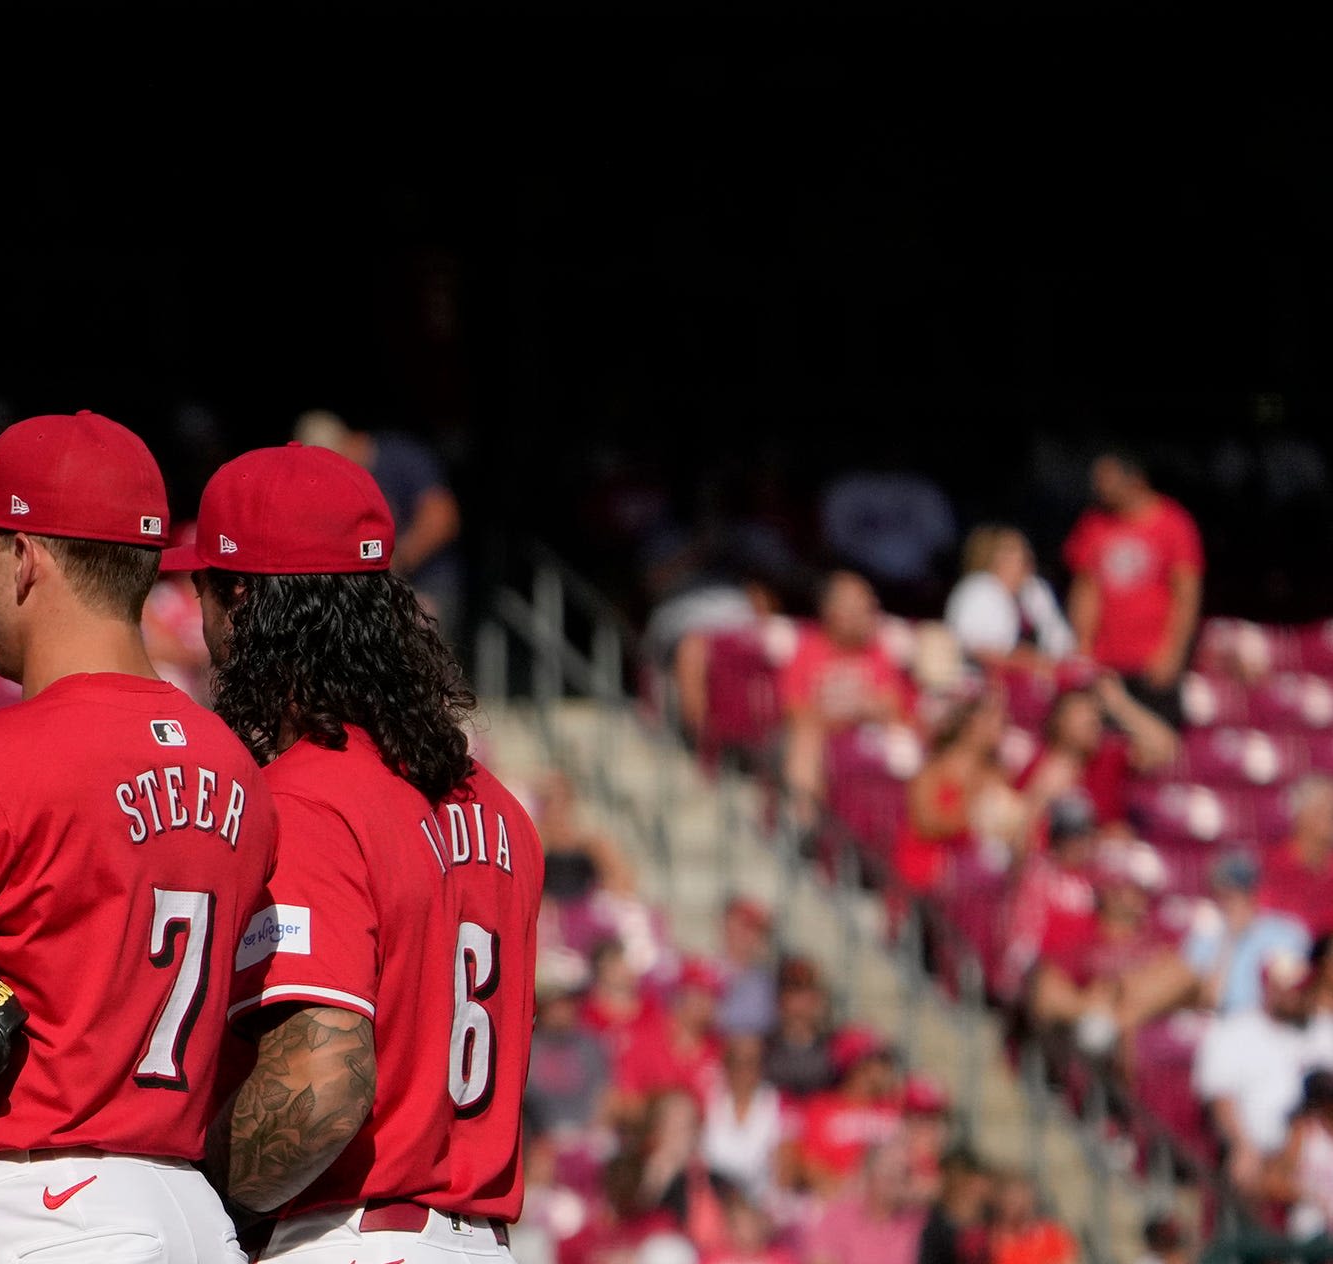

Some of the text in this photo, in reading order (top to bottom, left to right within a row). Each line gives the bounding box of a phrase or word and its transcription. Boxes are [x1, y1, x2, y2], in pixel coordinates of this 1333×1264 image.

[115, 765, 247, 848] STEER
[419, 802, 513, 876] IDIA
[134, 887, 215, 1088] 7
[446, 920, 500, 1119] 6
